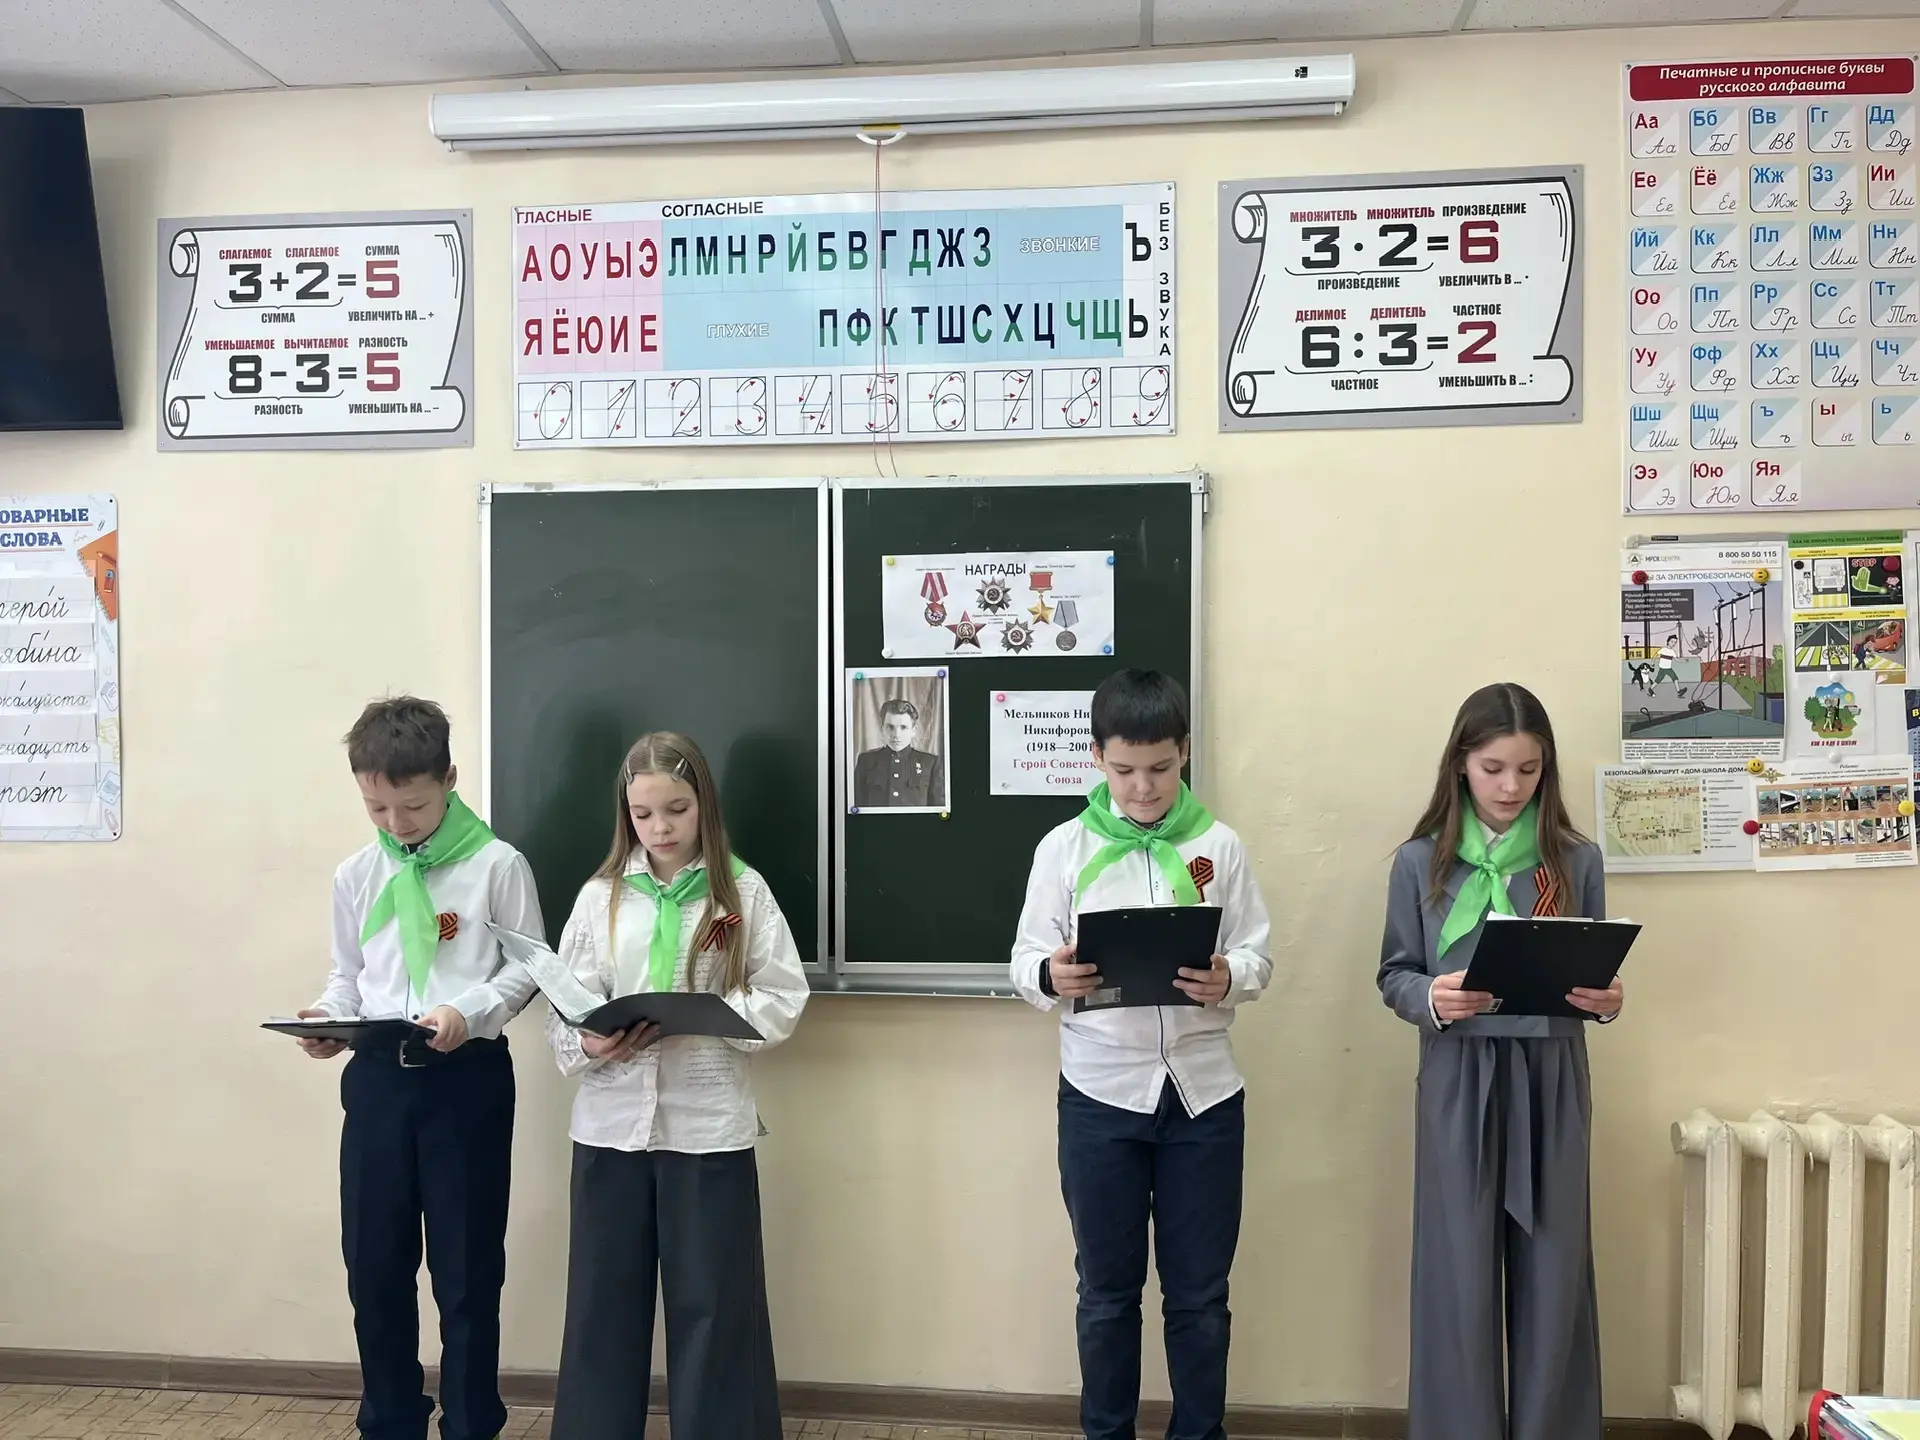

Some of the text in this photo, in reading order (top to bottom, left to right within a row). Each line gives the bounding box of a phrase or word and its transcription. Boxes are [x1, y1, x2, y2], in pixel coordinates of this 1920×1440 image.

[1660, 62, 1884, 79] Печатные и прописные буквы
[1700, 79, 1845, 96] русского алфавита
[662, 201, 763, 217] СОГЛАСНЫЕ
[1290, 203, 1527, 222] МНОЖИТЕЛЬ МНОЖИТЕЛЬ ПРОИЗВЕДЕНИЕ
[517, 209, 592, 223] ГЛАСНЫЕ
[1021, 236, 1099, 253] ЗВОНКИЕ
[219, 245, 400, 260] СЛАГАЕМОЕ СЛАГАЕМОЕ СУММА
[1318, 277, 1400, 290] ПРОИЗВЕДЕНИЕ
[1439, 275, 1501, 287] УВЕЛИЧИТЬ
[261, 313, 295, 323] СУММА
[348, 311, 402, 322] УВЕЛИЧИТЬ
[1296, 304, 1501, 322] ДЕЛИМОЕ ДЕЛИТЕЛЬ ЧАСТНОЕ
[708, 323, 769, 338] ГЛУХИЕ
[205, 337, 408, 351] УМЕНЬШАЕМОЕ ВЫЧИТАЕМОЕ РАЗНОСТЬ
[1331, 378, 1379, 391] ЧАСТНОЕ
[1439, 375, 1506, 388] УМЕНЬШИТЬ
[349, 403, 408, 414] УМЕНЬШИТЬ
[539, 366, 1169, 439] 0 1 2 3 4 5 6 7 8 9
[254, 404, 303, 415] РАЗНОСТЬ
[0, 532, 63, 547] СЛОВА
[965, 563, 1026, 576] НАГРАДЫ
[1668, 572, 1753, 580] ЭЛЕКТРОБЕЗОПАСНО
[1004, 709, 1090, 718] Мельников Ни
[1024, 725, 1090, 737] Никифоров
[1013, 759, 1097, 770] Герой Советск
[1046, 774, 1082, 784] Союза
